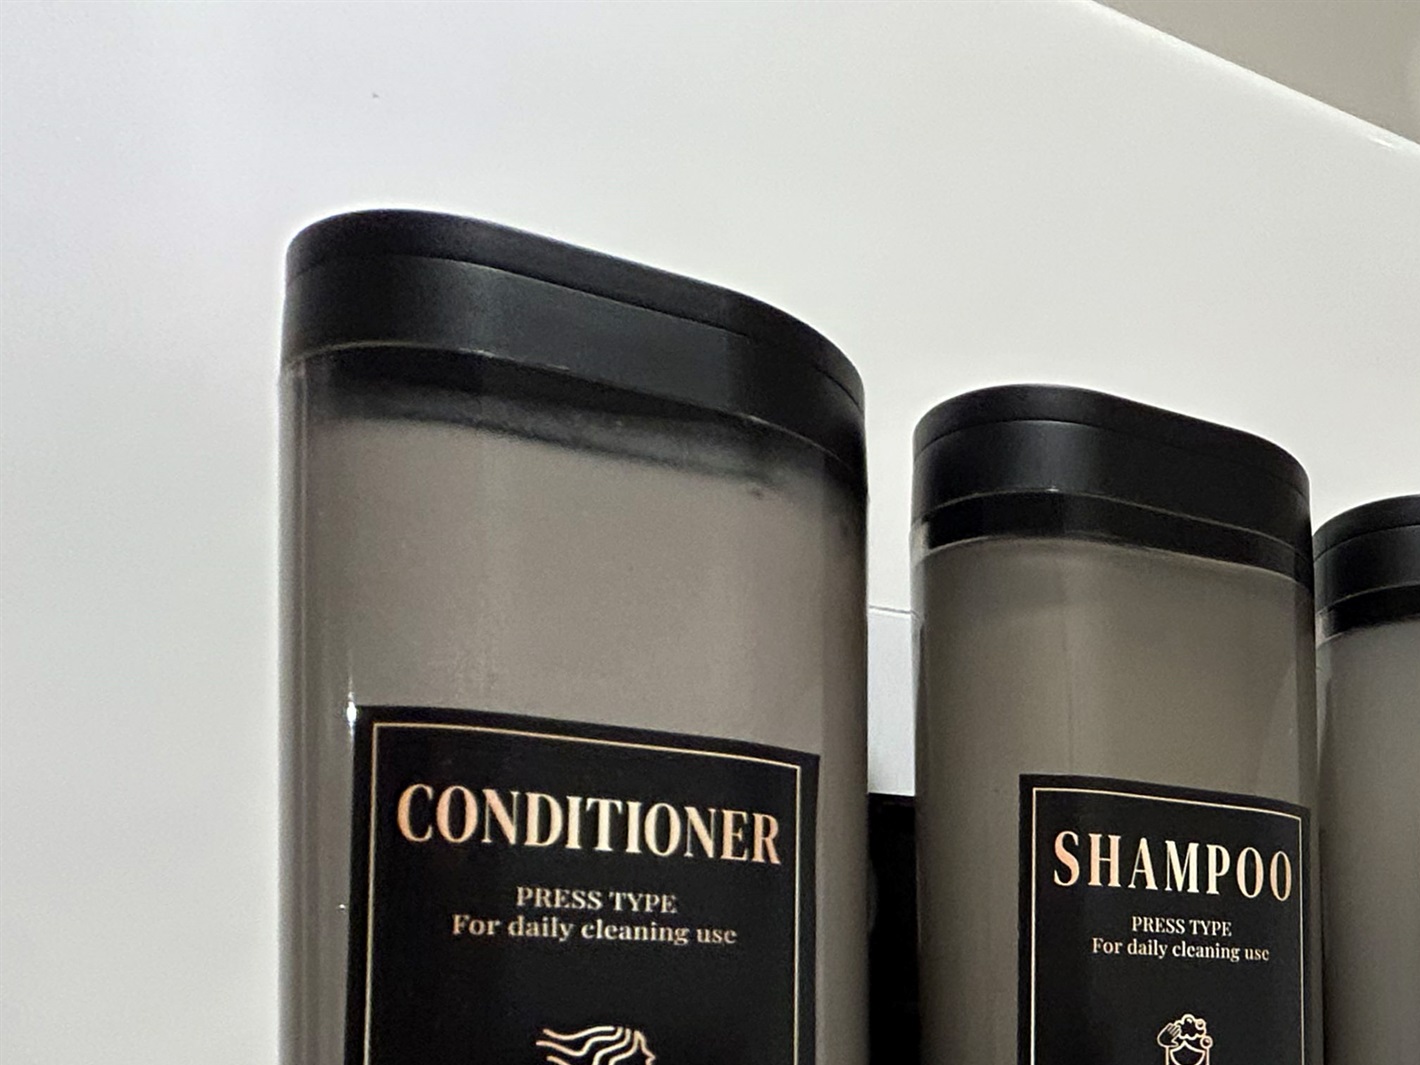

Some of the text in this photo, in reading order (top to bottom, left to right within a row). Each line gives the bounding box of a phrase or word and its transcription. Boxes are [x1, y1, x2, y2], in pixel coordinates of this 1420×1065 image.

[397, 783, 781, 865] CONDITIONER
[1053, 830, 1292, 901] SHAMPOO
[516, 886, 677, 914] PRESS TYPE
[452, 914, 738, 945] For daily cleaning use
[1132, 916, 1232, 937] PRESS TYPE
[1092, 938, 1270, 962] For daily cleaning use
